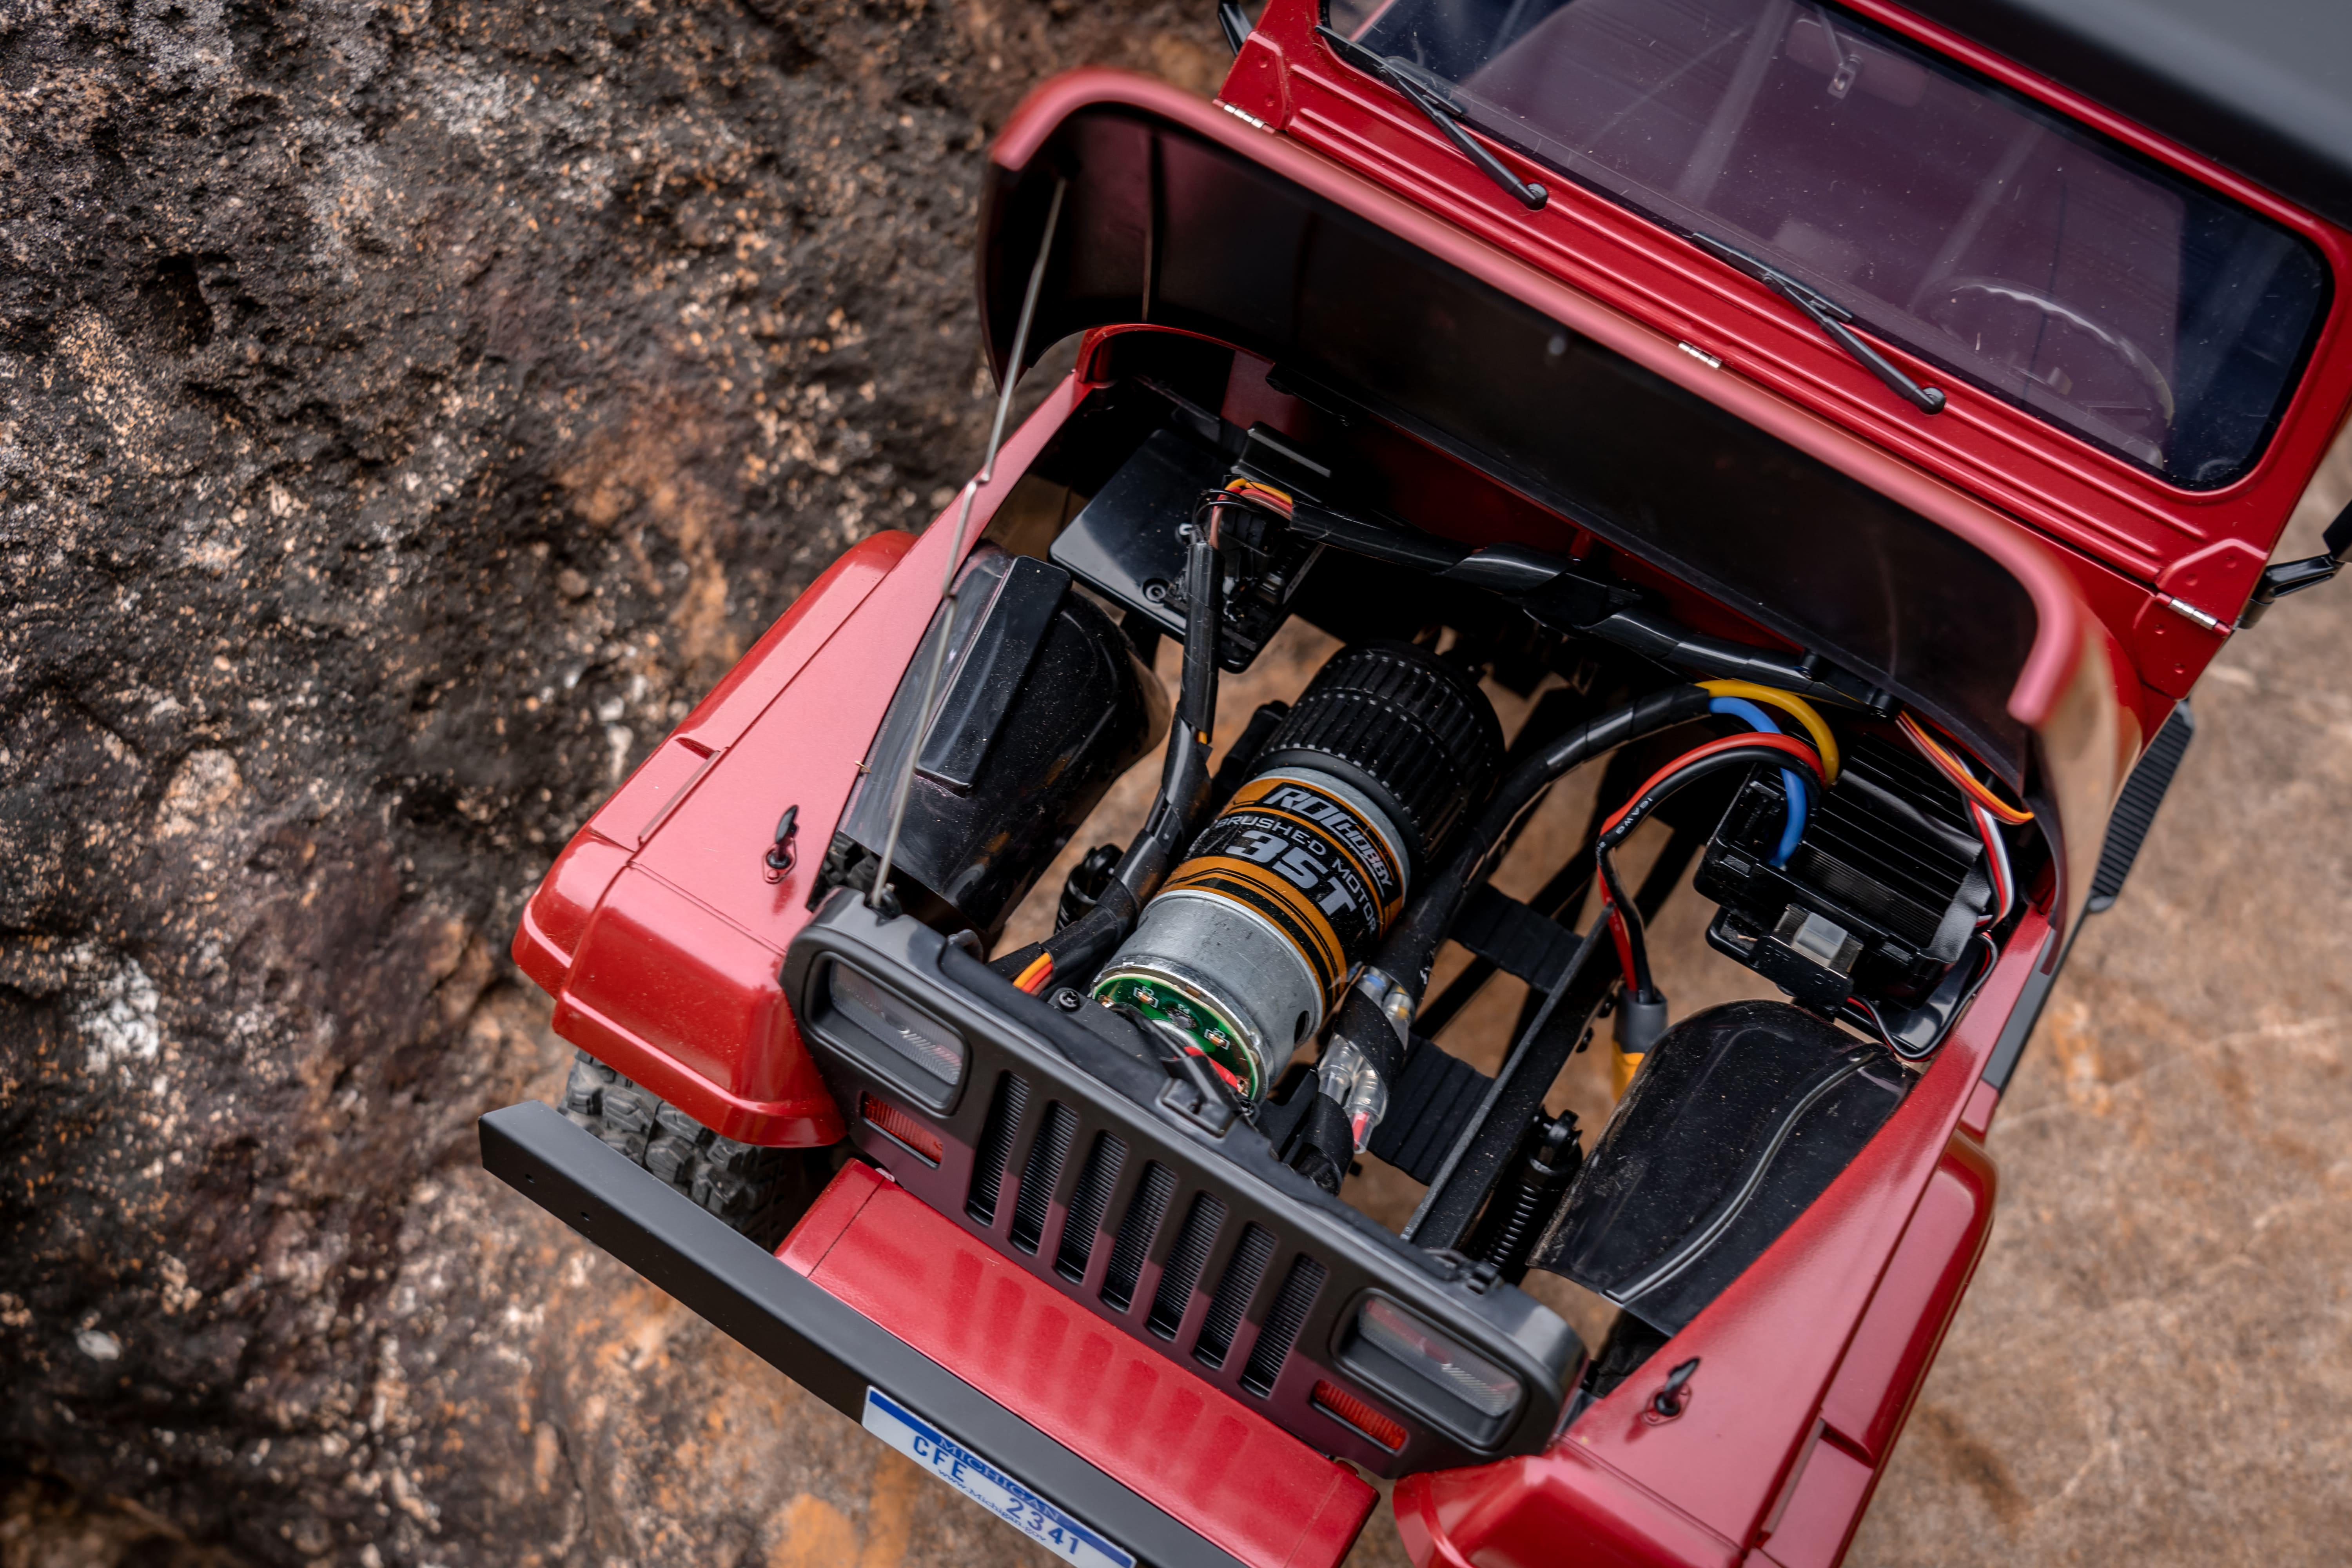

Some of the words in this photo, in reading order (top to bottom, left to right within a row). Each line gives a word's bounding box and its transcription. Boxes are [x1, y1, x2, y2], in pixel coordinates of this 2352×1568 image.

[1214, 816, 1327, 855] BRUSHED
[1331, 858, 1377, 935] MOTOR
[1225, 830, 1357, 916] 35T
[913, 1435, 968, 1483] CFE
[1005, 1497, 1079, 1555] 2341
[938, 1469, 1047, 1541] www.Michigan.gov
[939, 1437, 1061, 1521] MICHIGAN
